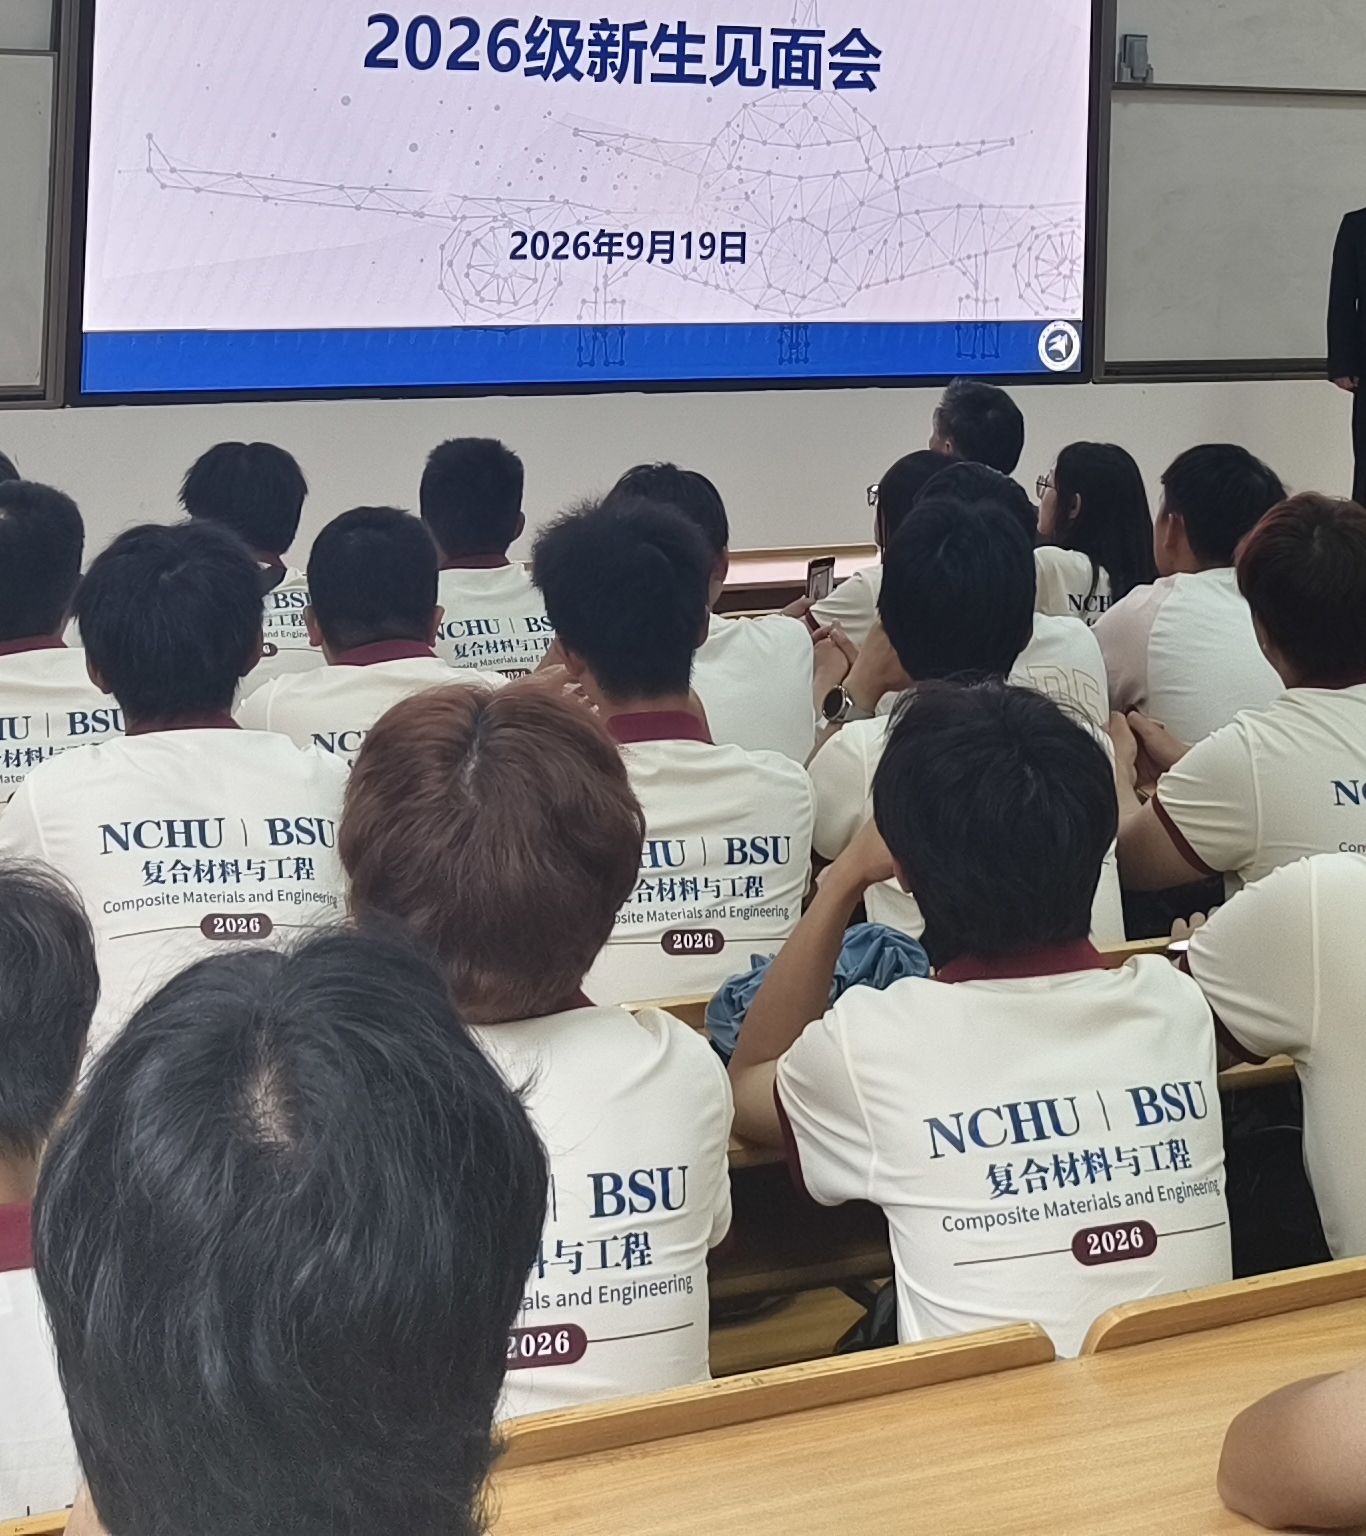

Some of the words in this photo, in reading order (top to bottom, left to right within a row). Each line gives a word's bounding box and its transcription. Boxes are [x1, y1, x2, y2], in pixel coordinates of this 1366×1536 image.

[363, 13, 883, 93] 2026级新生见面会
[508, 229, 748, 265] 2026年9月19日
[98, 817, 225, 855] NCHU
[264, 817, 335, 848] BSU
[641, 839, 685, 869] HU
[723, 836, 791, 866] BSU
[142, 857, 315, 886] 复合材料与工程
[103, 891, 179, 914] Composite
[183, 890, 245, 904] Materials
[248, 889, 273, 902] and
[623, 875, 764, 904] 合材料与工程
[213, 917, 261, 933] 2026
[647, 907, 702, 923] Materials
[705, 906, 726, 919] and
[729, 905, 789, 921] Engineering
[673, 933, 714, 949] 2026
[923, 1096, 1080, 1159] NCHU
[1125, 1081, 1208, 1127] BSU
[986, 1138, 1192, 1200] 复合材料与工程
[587, 1165, 688, 1219] BSU
[942, 1205, 1040, 1232] Composite
[1044, 1194, 1122, 1220] Materials
[1125, 1185, 1154, 1207] and
[1158, 1177, 1221, 1205] Engineering
[1087, 1227, 1144, 1255] 2026
[556, 1286, 591, 1308] and
[599, 1274, 693, 1306] Engineering
[507, 1330, 570, 1359] 2026
